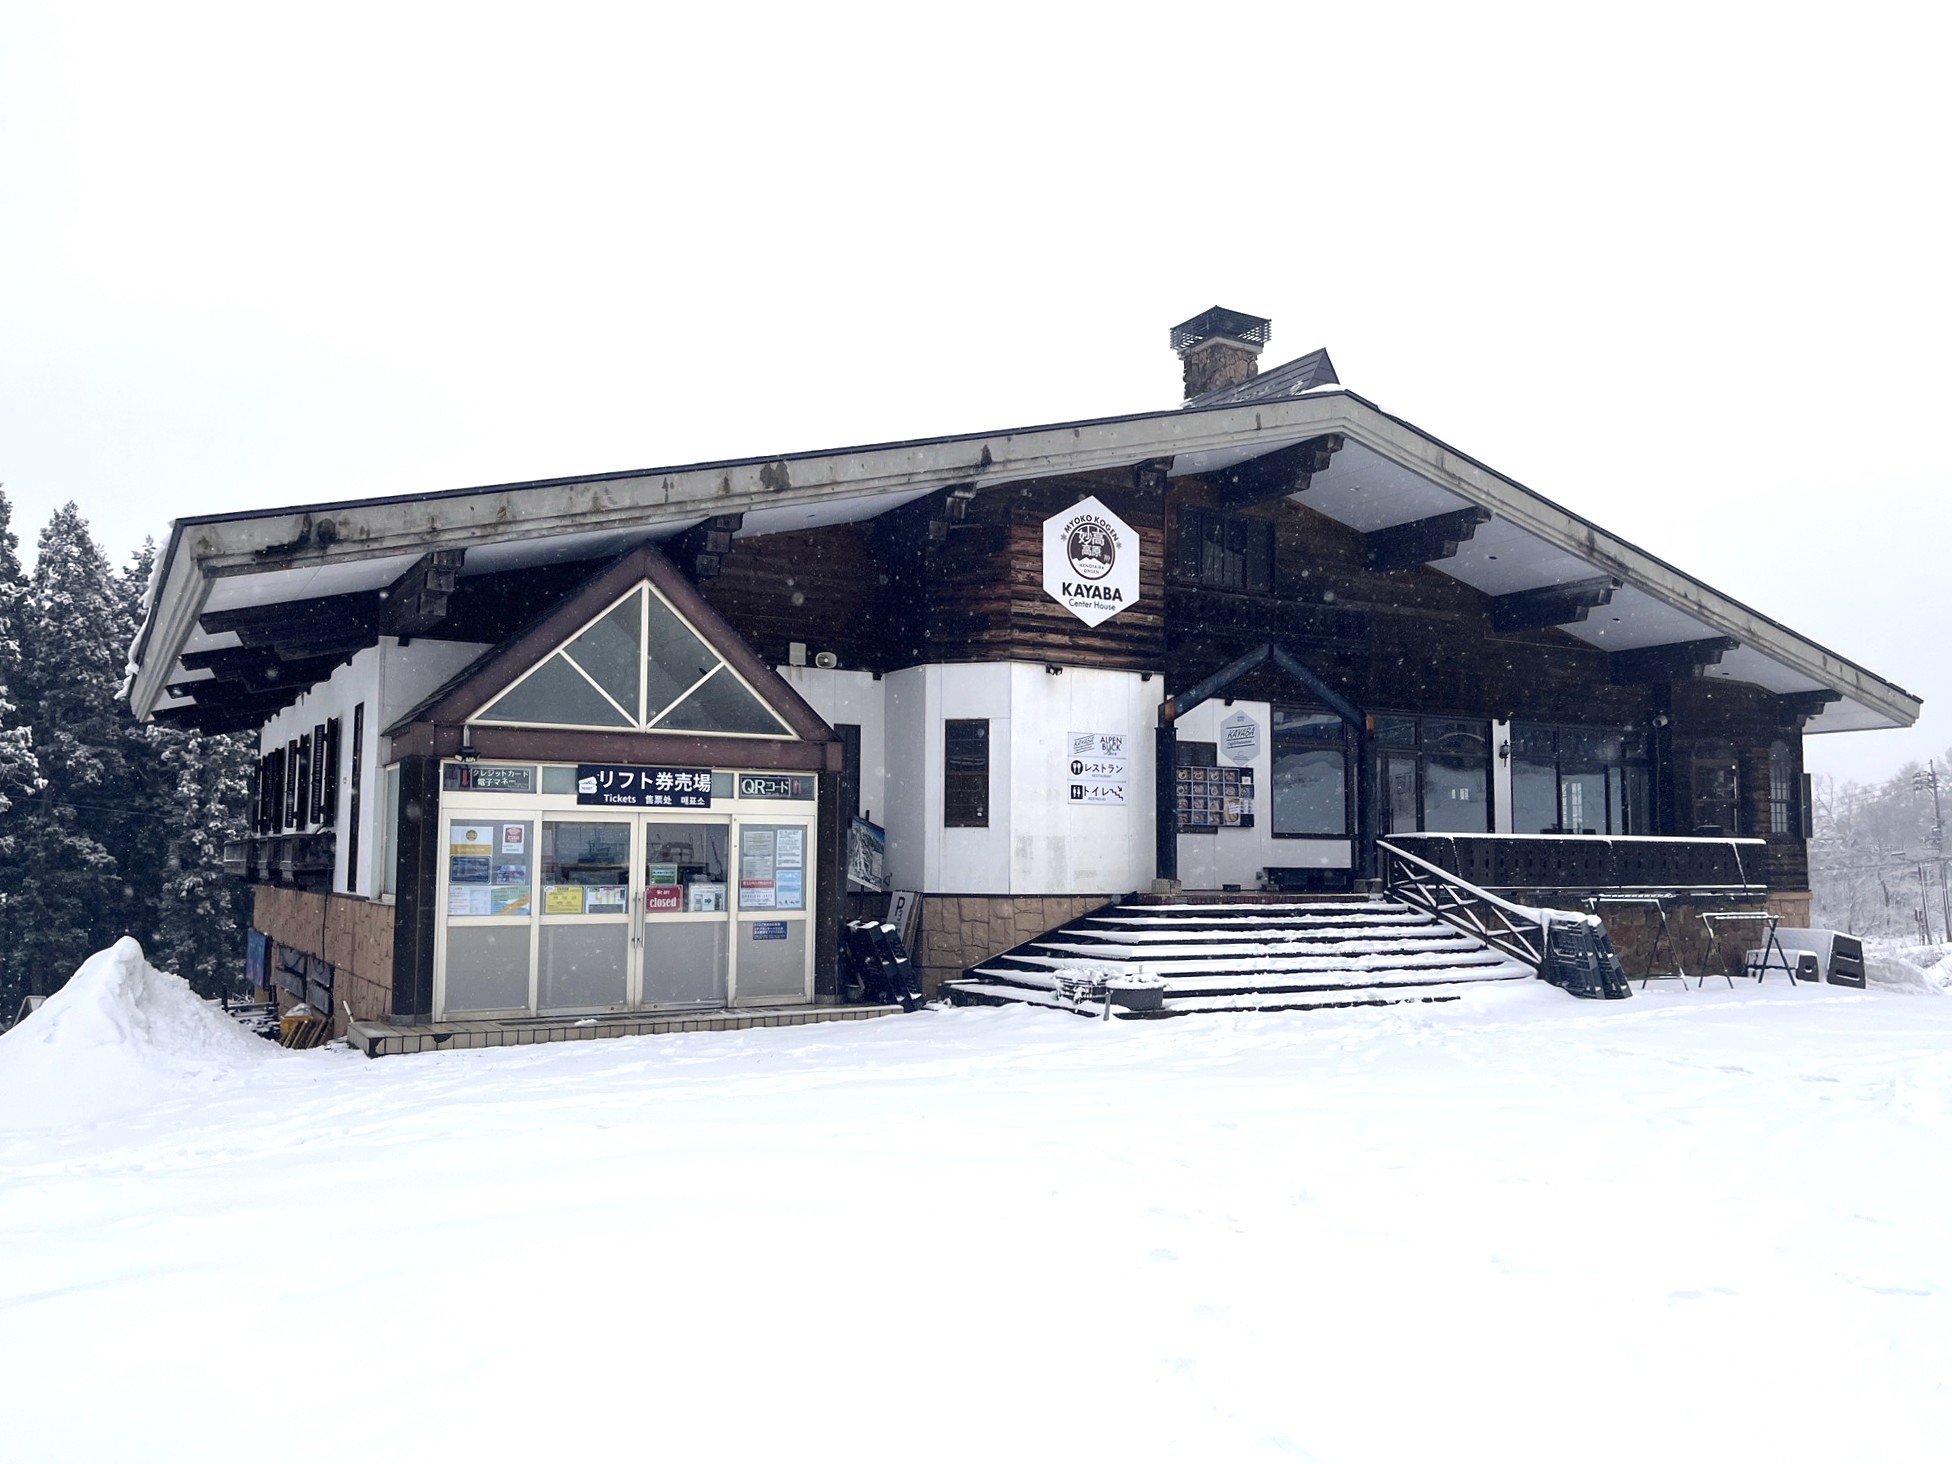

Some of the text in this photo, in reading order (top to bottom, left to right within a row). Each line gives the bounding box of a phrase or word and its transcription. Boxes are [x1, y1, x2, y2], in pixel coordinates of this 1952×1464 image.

[1065, 515, 1119, 541] MYOKO KOGEN
[1078, 526, 1105, 546] 妙高
[1081, 545, 1102, 557] 高原
[1062, 582, 1123, 602] KAYABA
[1068, 598, 1116, 611] Center House
[1227, 727, 1256, 740] KAYABA
[1099, 736, 1123, 744] ALPEN
[1101, 742, 1121, 751] BUCK
[473, 769, 529, 778] クレジットカード
[1084, 763, 1123, 774] レストラン
[477, 778, 516, 787] 電子マネー
[600, 770, 712, 793] リフト券売場
[741, 779, 789, 794] QRコード
[1084, 785, 1109, 797] トイレ
[603, 794, 637, 804] Tickets
[645, 795, 672, 805] 售票处
[680, 796, 705, 806] 매표소
[649, 897, 677, 908] closed
